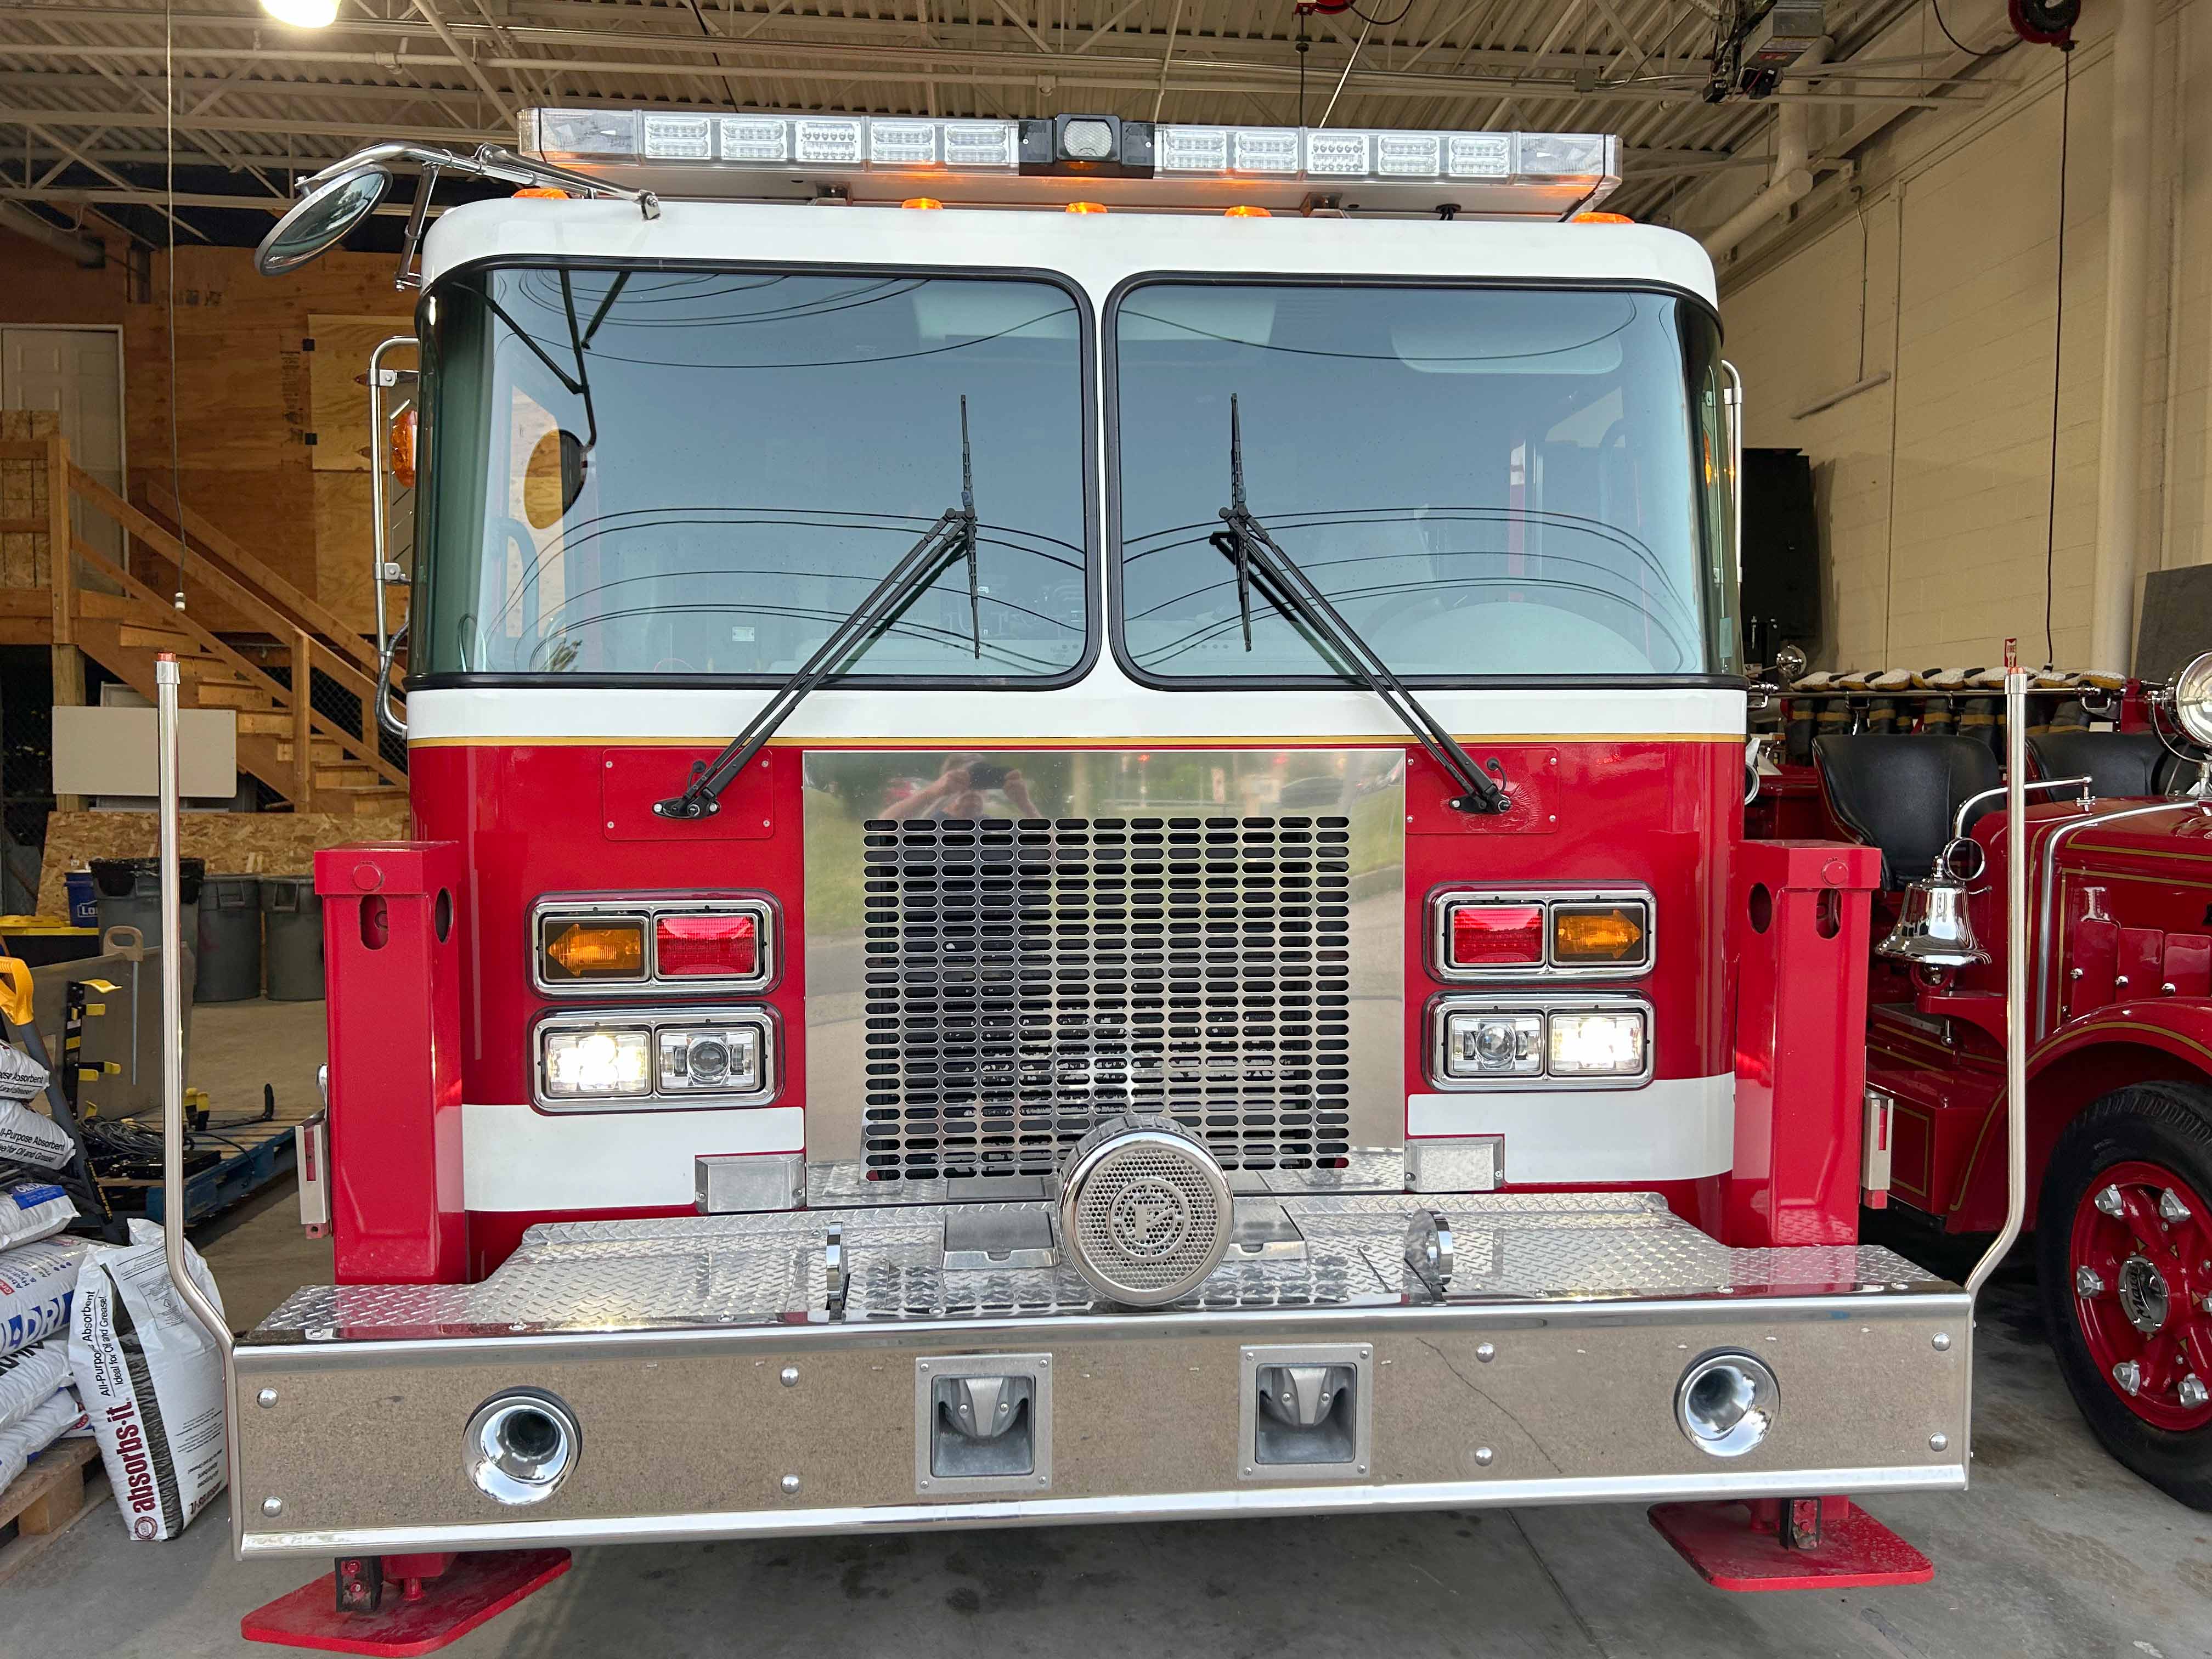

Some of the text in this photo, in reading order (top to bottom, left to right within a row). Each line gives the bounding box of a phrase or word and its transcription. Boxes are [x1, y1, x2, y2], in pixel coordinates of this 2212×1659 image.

[13, 1071, 43, 1084] Absorbent
[33, 1136, 65, 1152] Absorbent
[81, 1291, 95, 1342] Absorbent
[99, 1329, 110, 1342] and
[103, 1342, 114, 1353] Oil
[109, 1353, 119, 1365] for
[110, 1366, 123, 1385] Ideal
